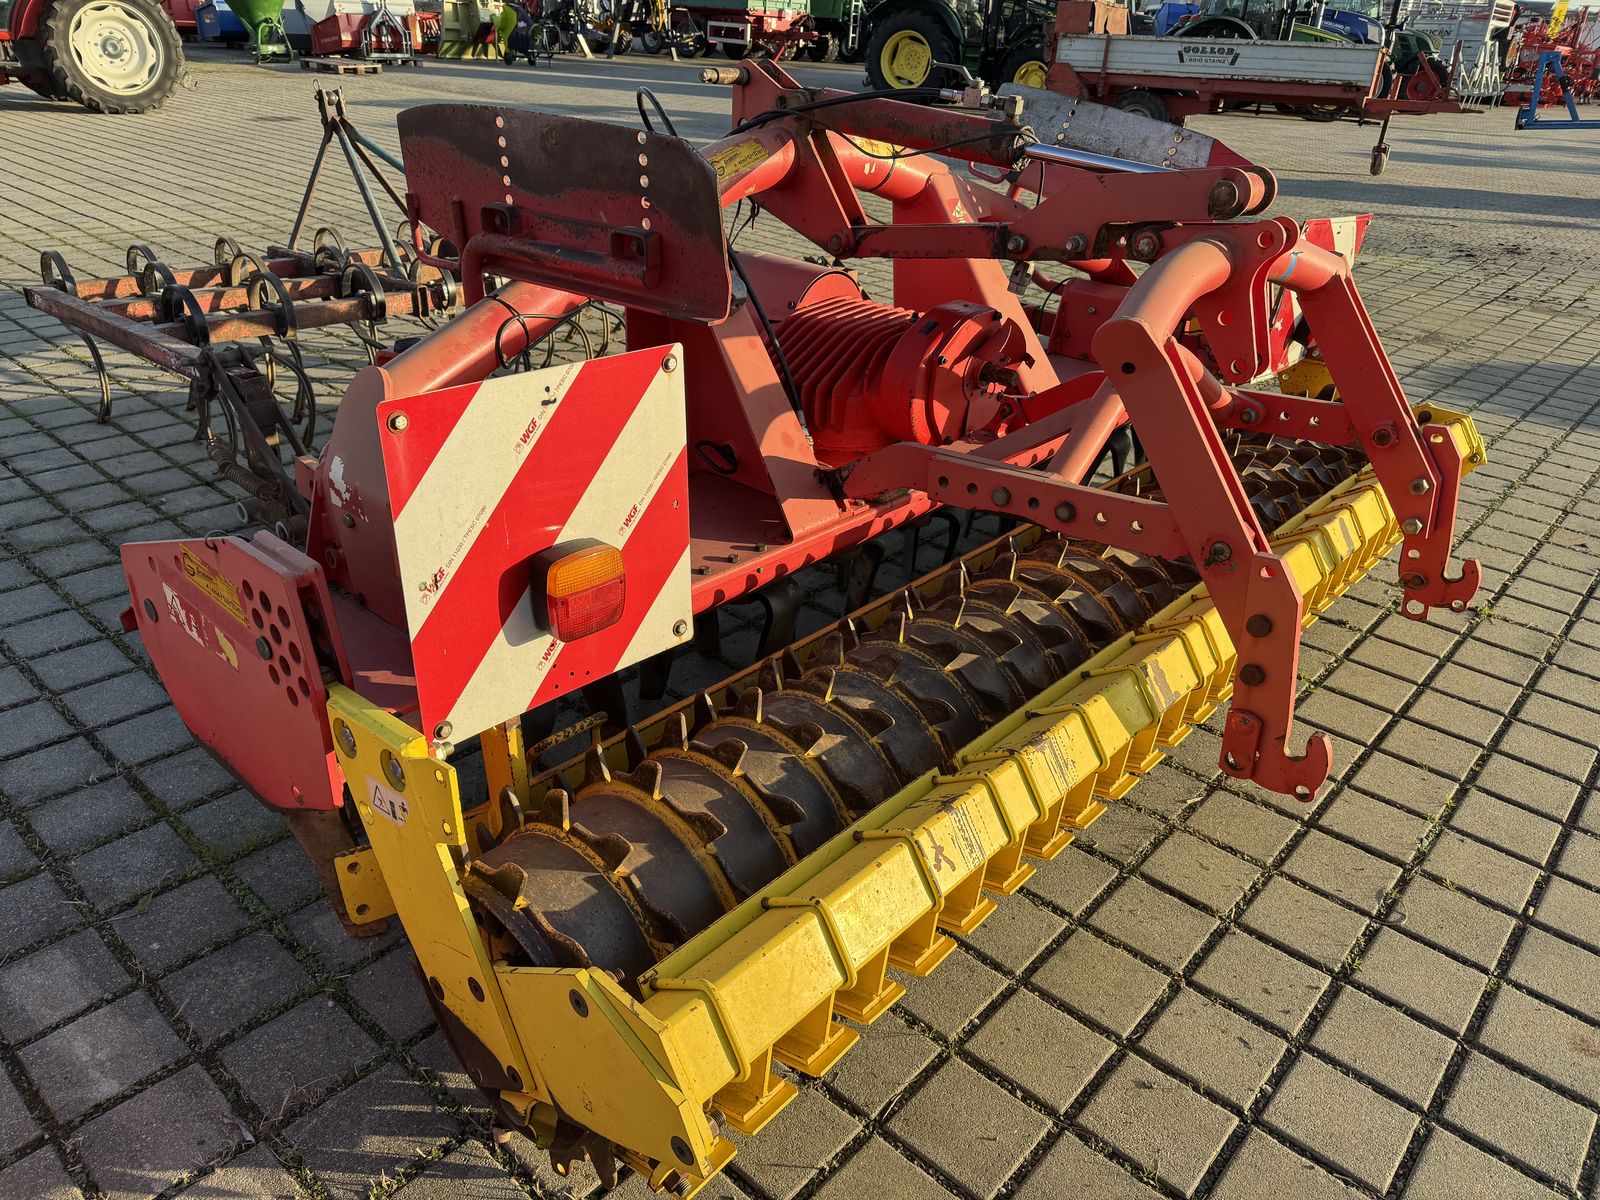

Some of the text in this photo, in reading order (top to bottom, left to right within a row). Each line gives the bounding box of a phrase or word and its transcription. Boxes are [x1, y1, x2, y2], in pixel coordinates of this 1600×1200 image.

[520, 417, 537, 444] WGF
[537, 409, 546, 420] DIN
[622, 503, 639, 528] WGF
